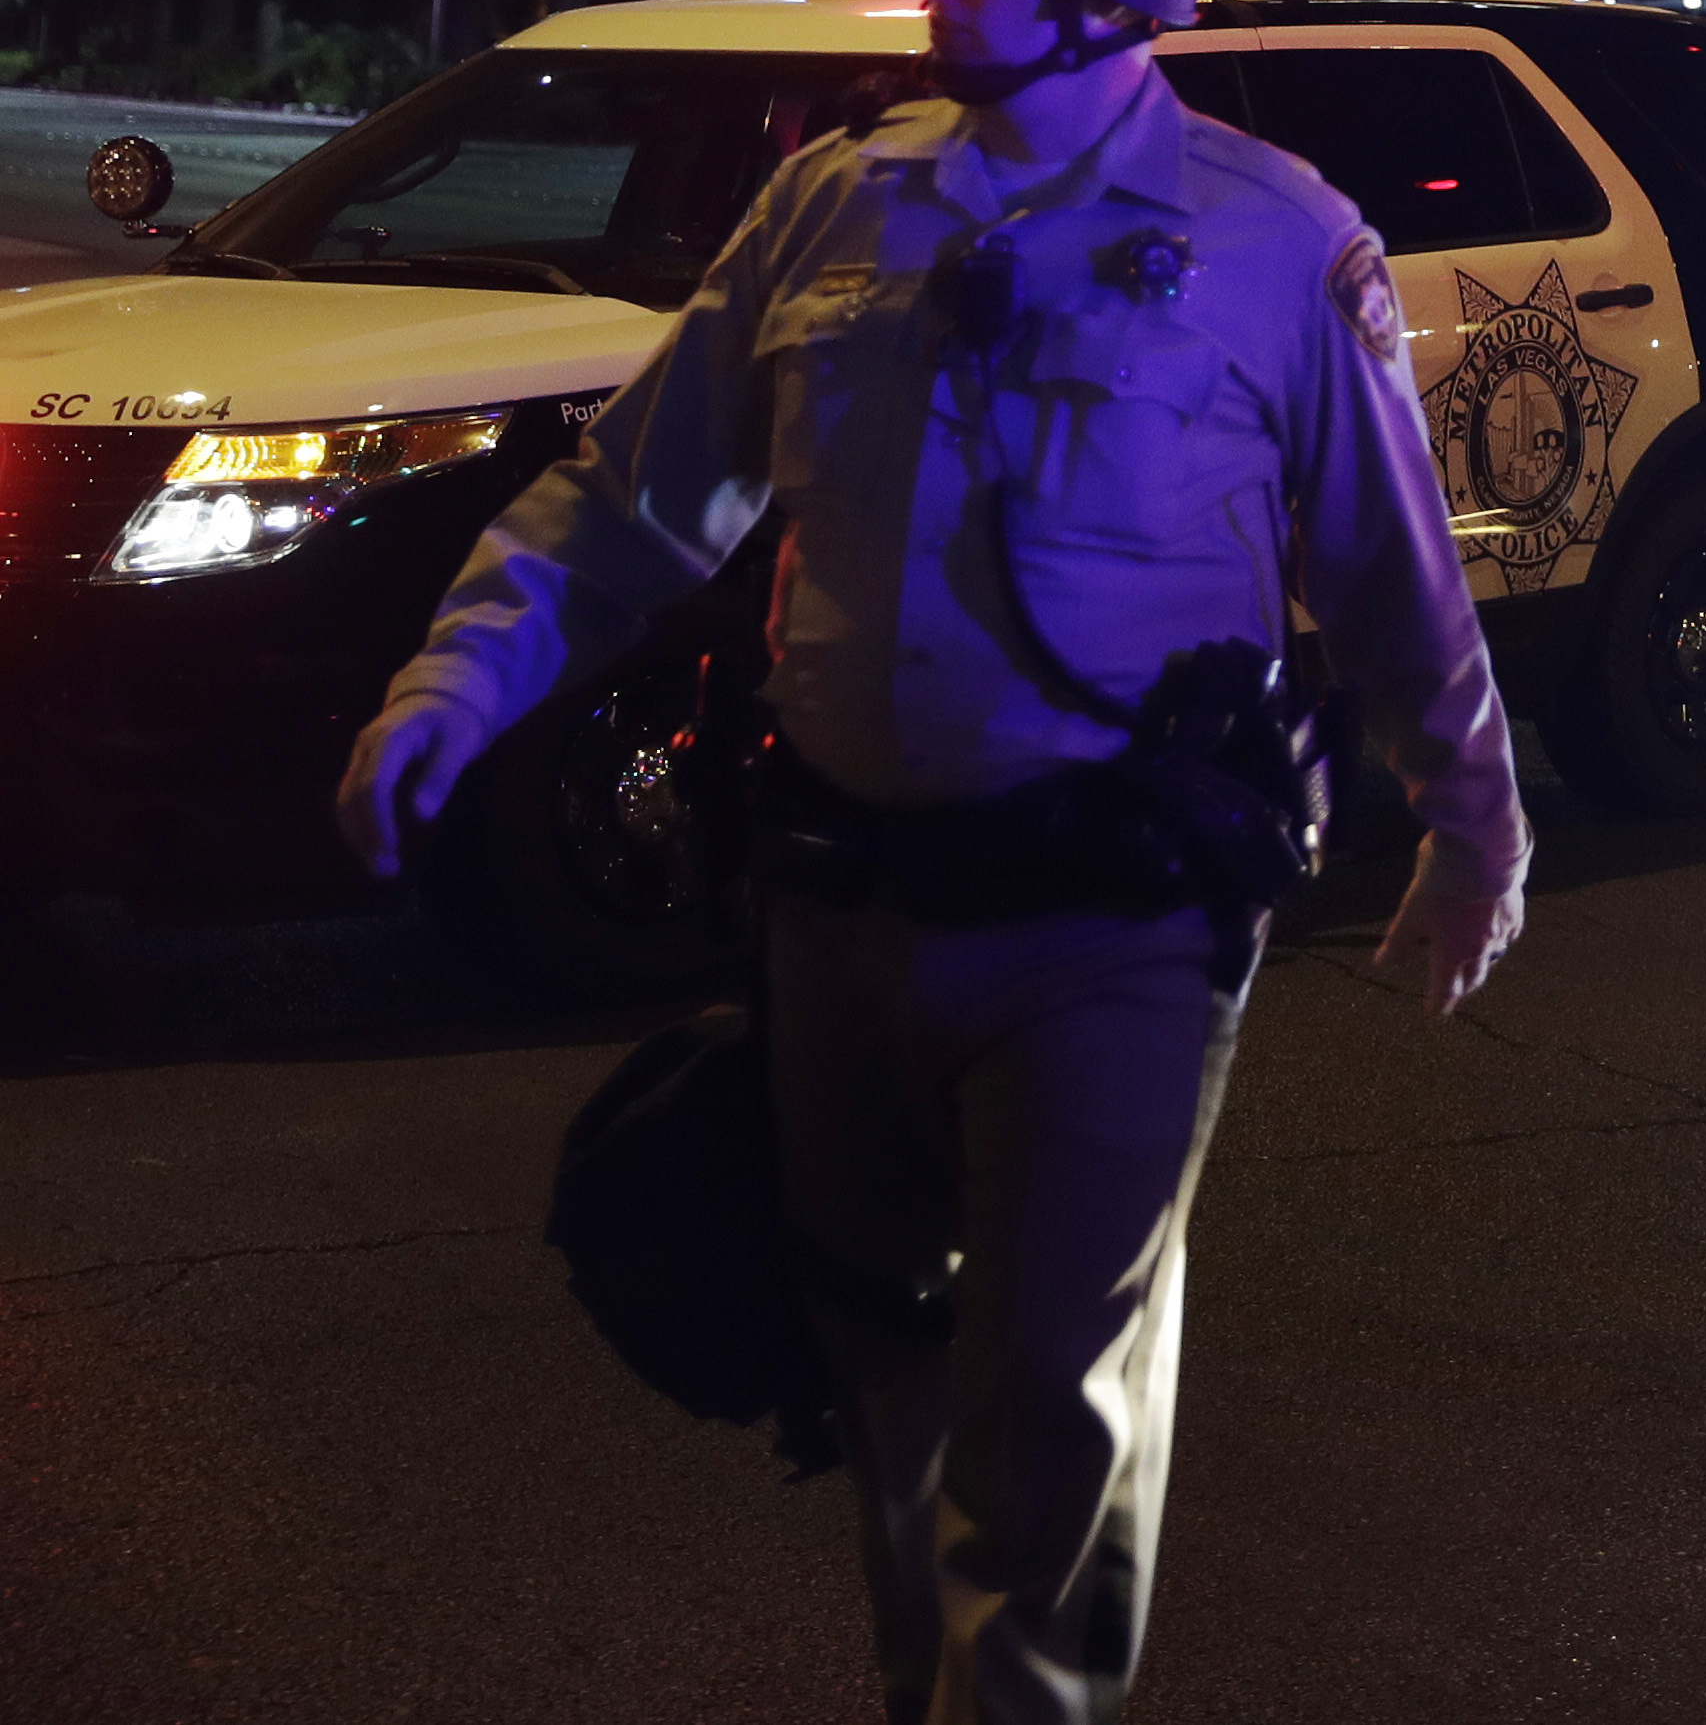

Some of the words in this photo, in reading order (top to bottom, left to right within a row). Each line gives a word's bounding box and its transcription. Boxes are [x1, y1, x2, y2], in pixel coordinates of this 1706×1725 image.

[1450, 313, 1601, 441] METROPOLITAN
[1478, 358, 1508, 405] LAS
[1515, 350, 1569, 397] VEGAS
[30, 393, 91, 420] SC
